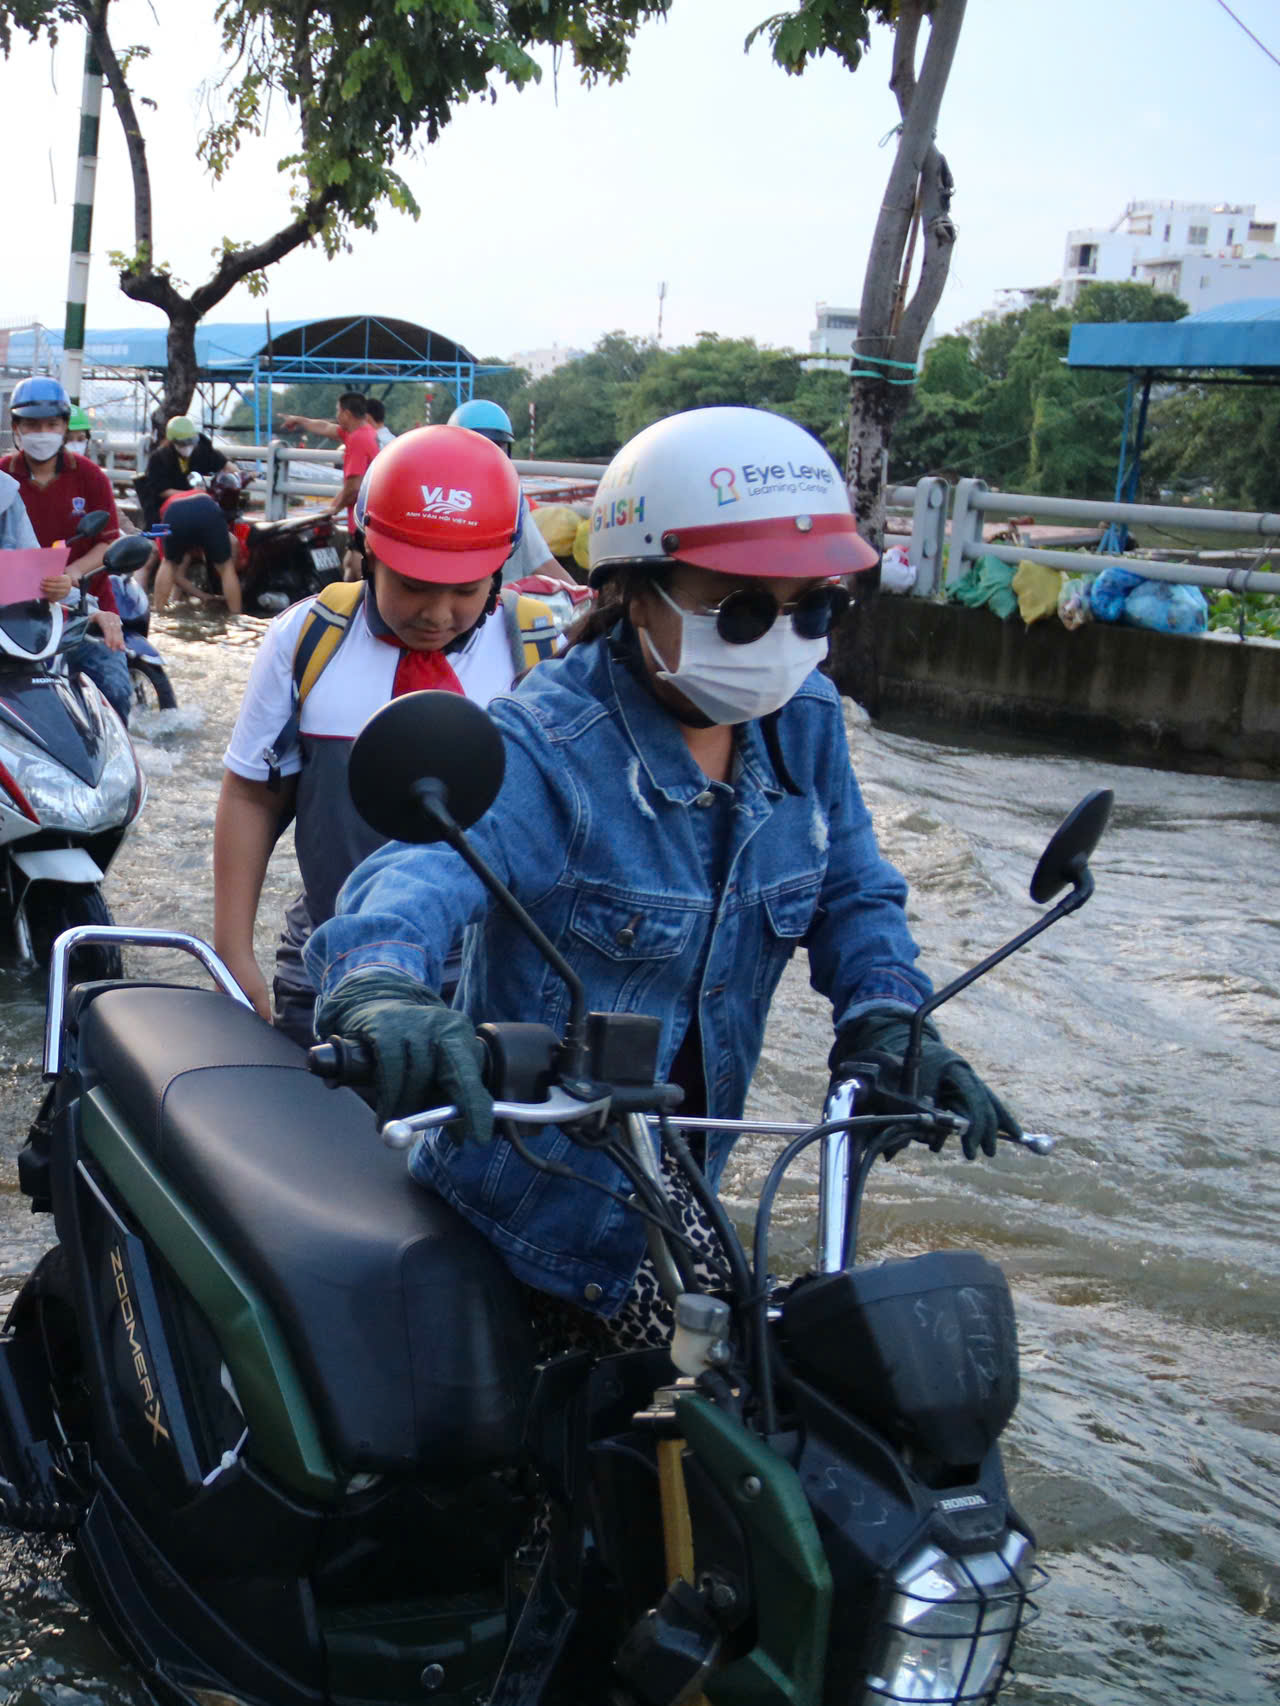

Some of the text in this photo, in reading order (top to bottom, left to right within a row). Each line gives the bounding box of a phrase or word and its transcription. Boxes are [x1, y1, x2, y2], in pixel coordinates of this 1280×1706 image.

[742, 464, 785, 485] Eye
[421, 484, 473, 510] VUS
[940, 1495, 987, 1510] HONDA
